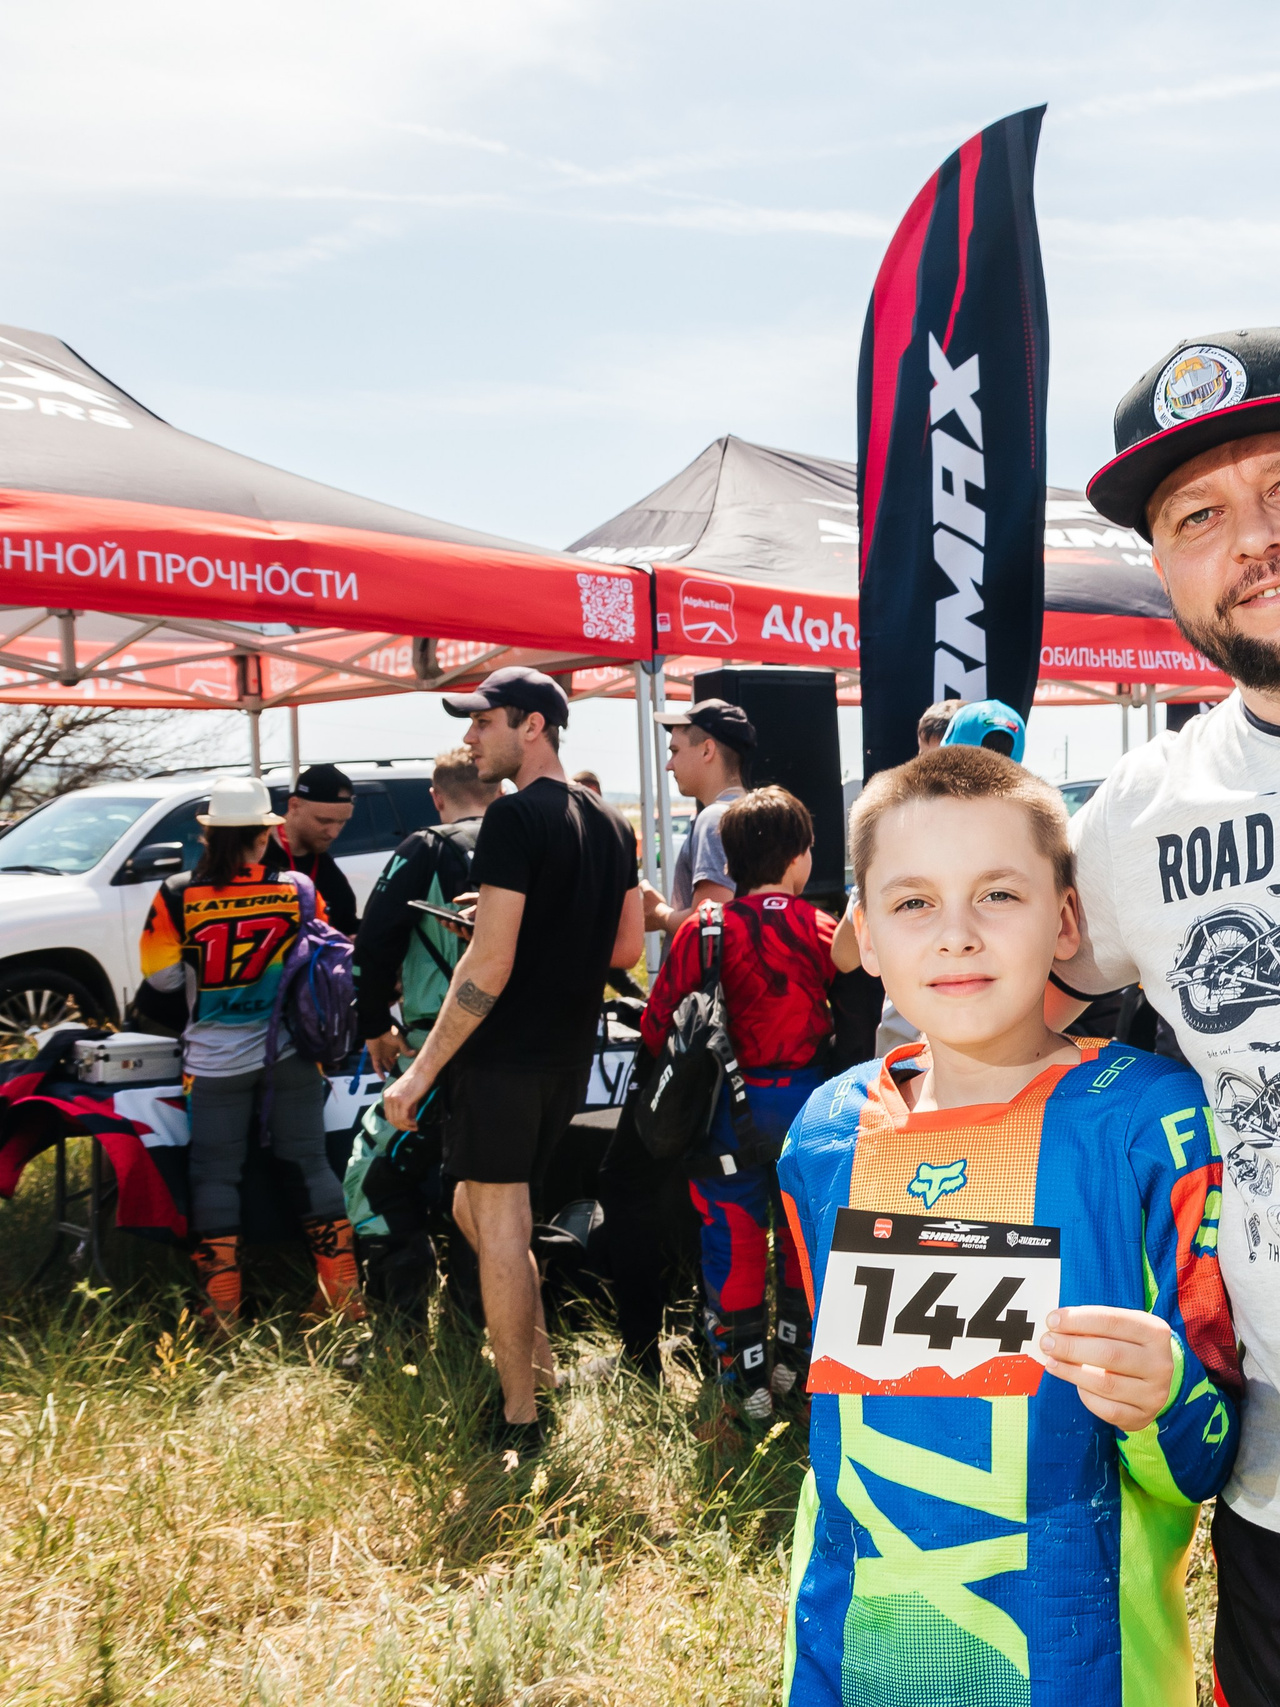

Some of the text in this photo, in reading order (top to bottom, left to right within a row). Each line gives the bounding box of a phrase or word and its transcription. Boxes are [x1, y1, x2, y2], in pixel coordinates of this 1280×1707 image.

[0, 537, 359, 601] ННОЙ ПРОЧНОСТИ
[761, 604, 860, 652] Alph
[1138, 650, 1195, 672] ШАТРЫ
[1155, 811, 1275, 905] ROAD
[193, 915, 291, 986] 17
[917, 1230, 991, 1246] SHARMAX
[961, 1242, 988, 1250] MOTORS
[853, 1264, 1036, 1354] 144
